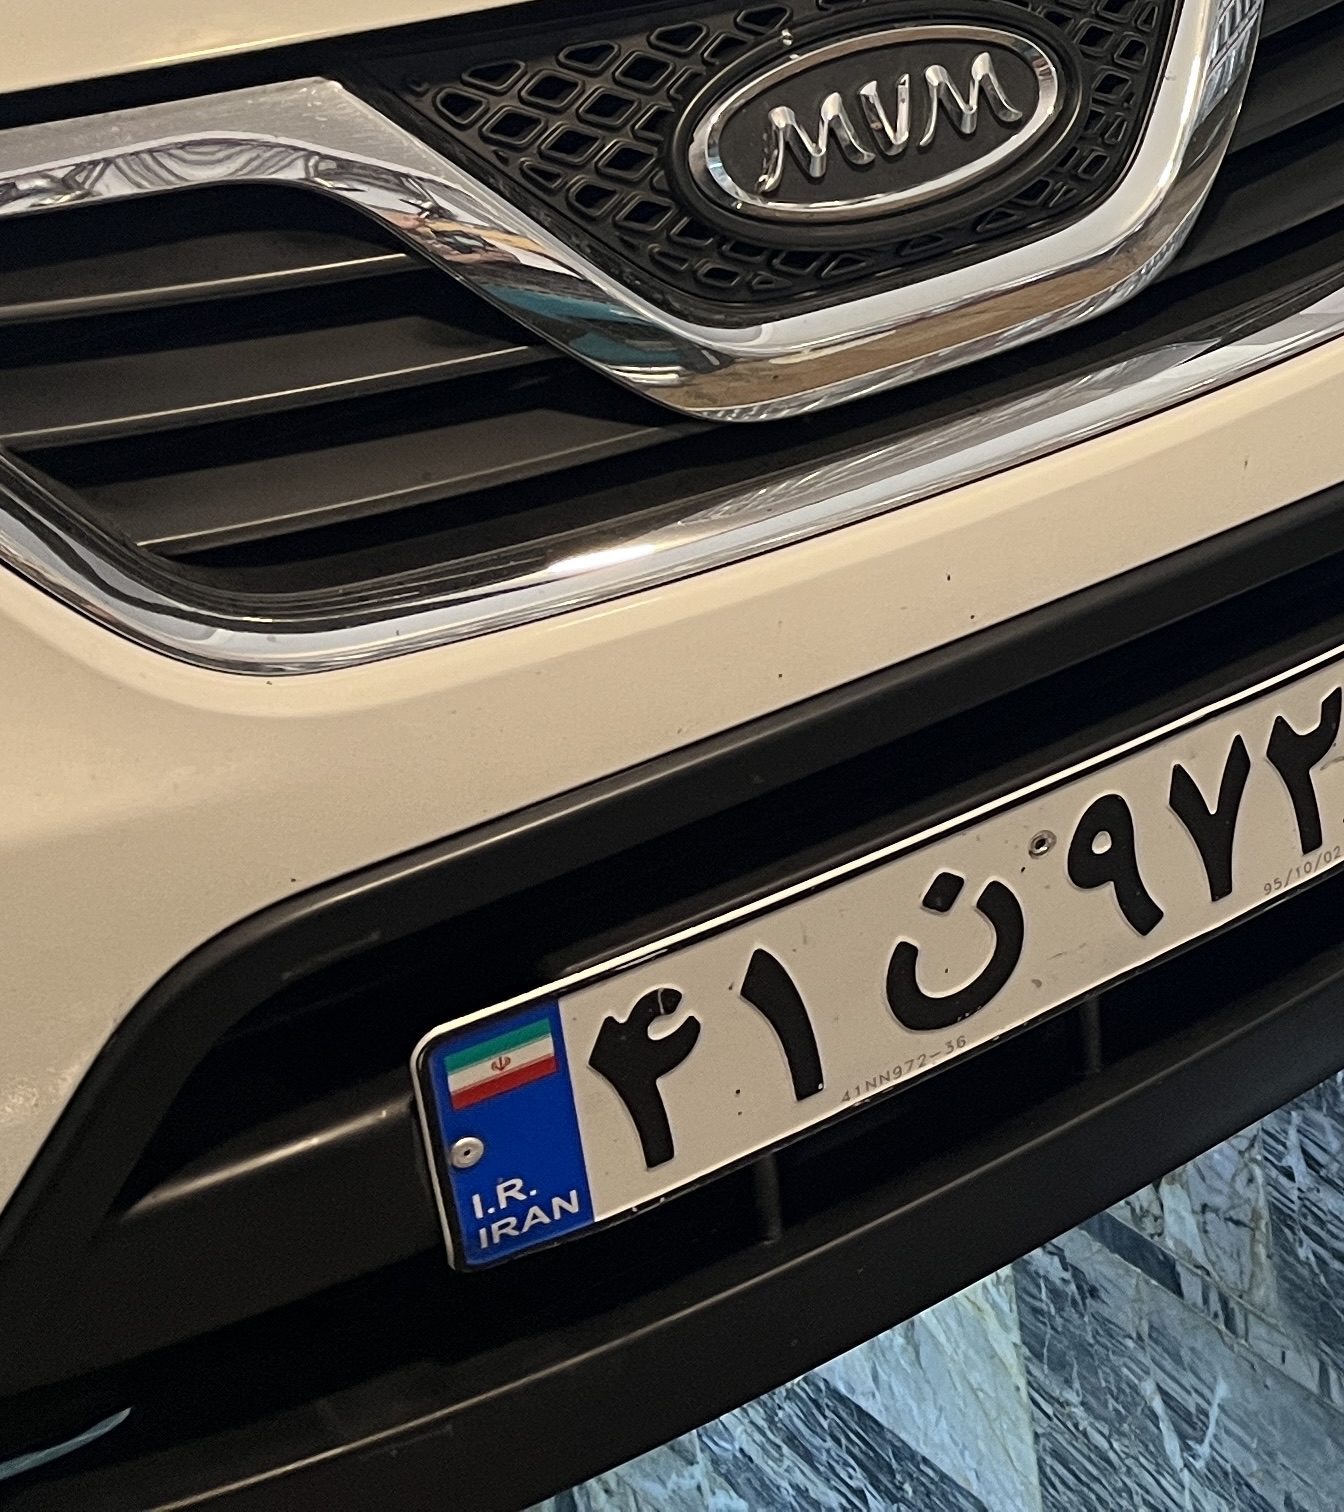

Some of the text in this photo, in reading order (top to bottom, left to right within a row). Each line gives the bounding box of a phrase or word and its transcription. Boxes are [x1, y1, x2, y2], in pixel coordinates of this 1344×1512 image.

[754, 51, 1022, 193] MVM
[1263, 845, 1342, 896] 95/10/02
[588, 947, 825, 1171] ۴۱
[885, 871, 1025, 1032] ن
[1066, 685, 1344, 938] ۹۷۲
[840, 1035, 967, 1103] 41NN972-36
[472, 1178, 537, 1219] I.R.
[479, 1190, 579, 1248] IRAN
